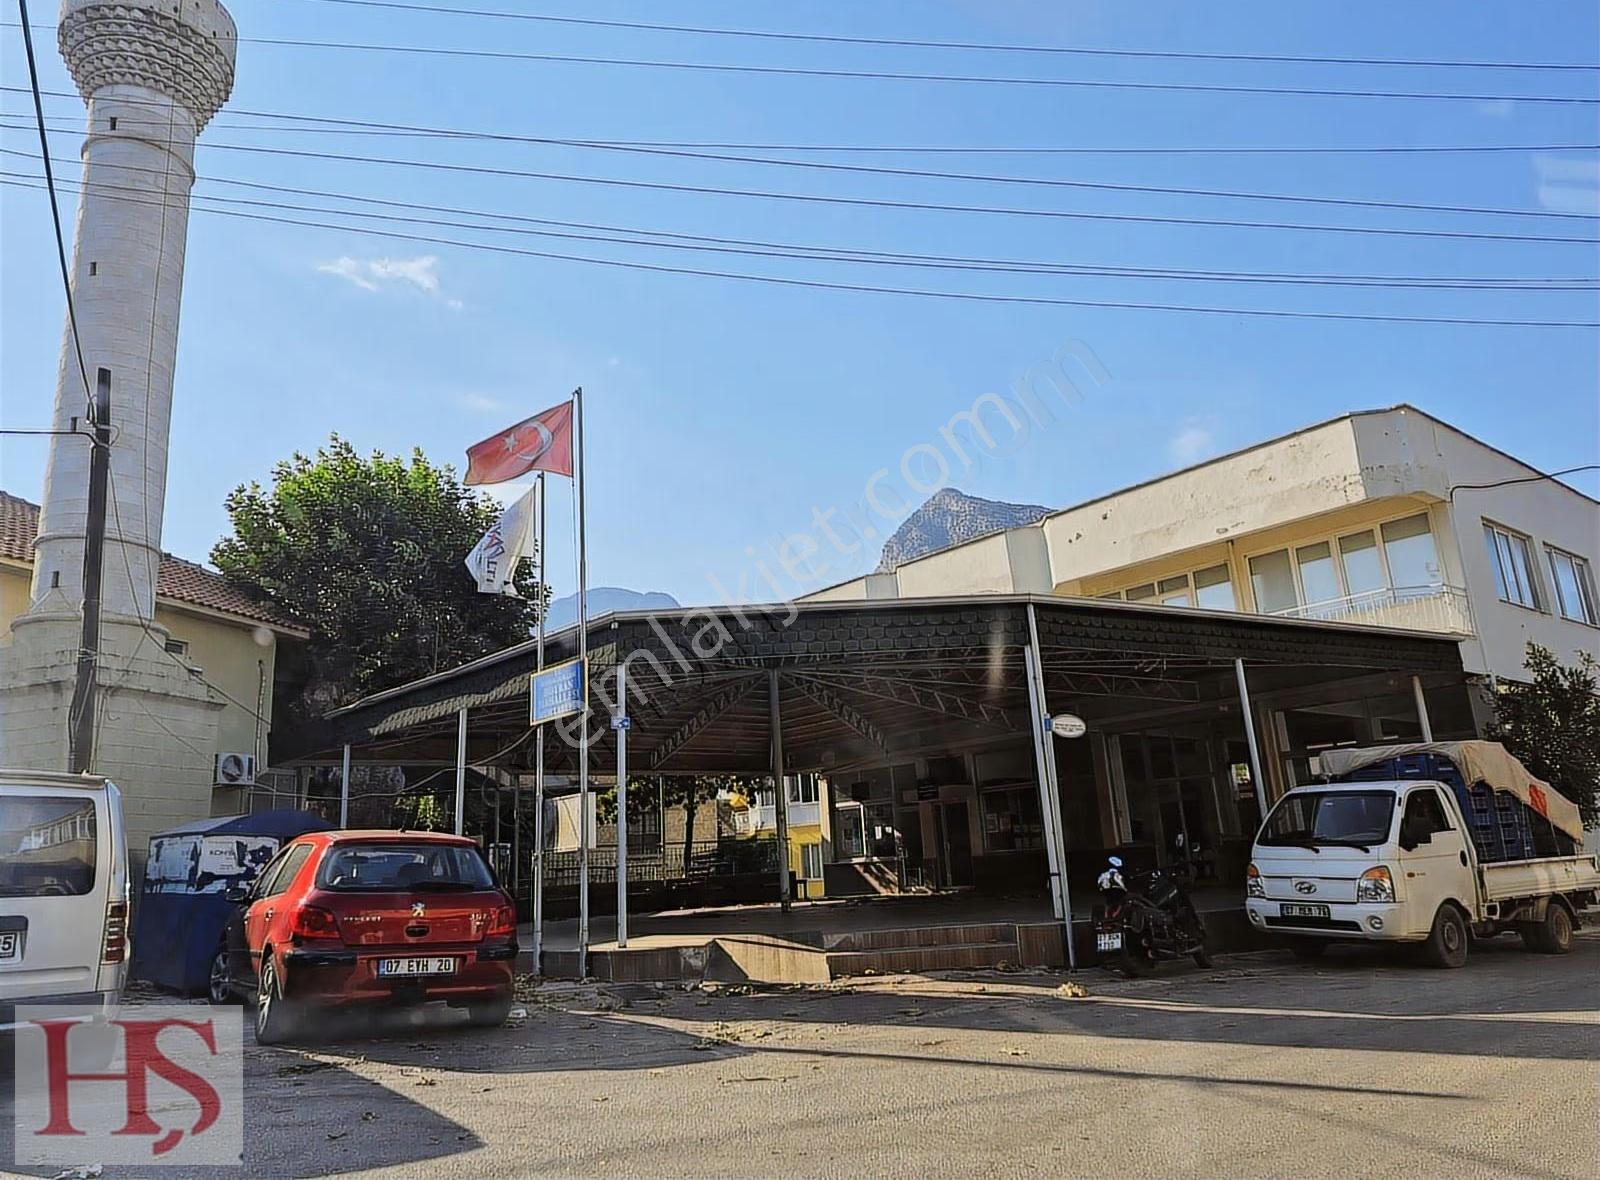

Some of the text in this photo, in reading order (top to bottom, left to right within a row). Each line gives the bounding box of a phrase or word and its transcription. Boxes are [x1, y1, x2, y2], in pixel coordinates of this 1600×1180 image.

[386, 958, 451, 973] 07 EYH 20
